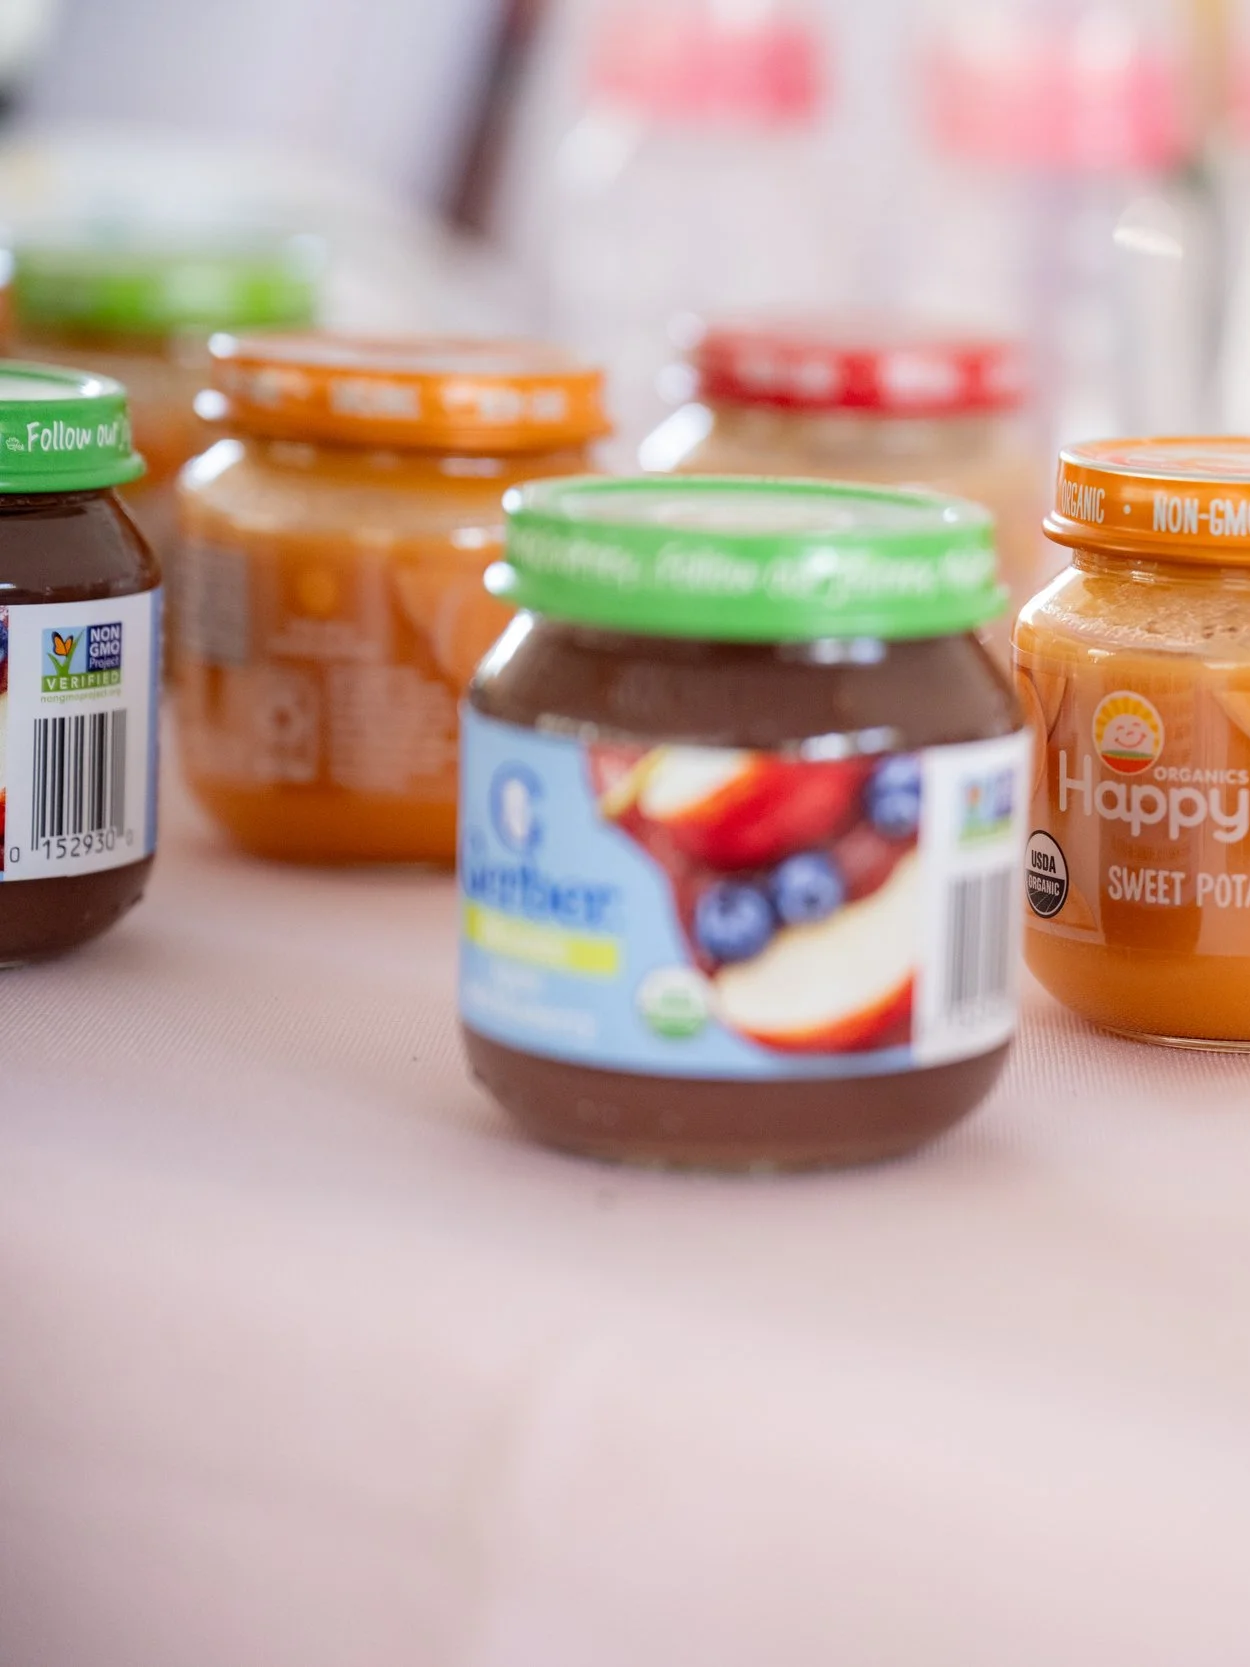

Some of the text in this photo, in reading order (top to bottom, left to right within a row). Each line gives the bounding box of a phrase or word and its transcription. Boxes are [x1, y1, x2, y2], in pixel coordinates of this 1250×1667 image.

[26, 420, 92, 452] Follow
[1062, 478, 1105, 524] ORGANIC
[90, 625, 120, 642] NON
[89, 640, 120, 657] GMO
[89, 656, 119, 670] Project
[46, 670, 119, 690] VERIFIED
[1154, 767, 1249, 786] ORGANICS
[9, 846, 20, 863] 0
[42, 829, 115, 860] 152930
[1031, 849, 1057, 874] USDA
[1028, 874, 1060, 897] ORGANIC
[1108, 865, 1186, 906] SWEET
